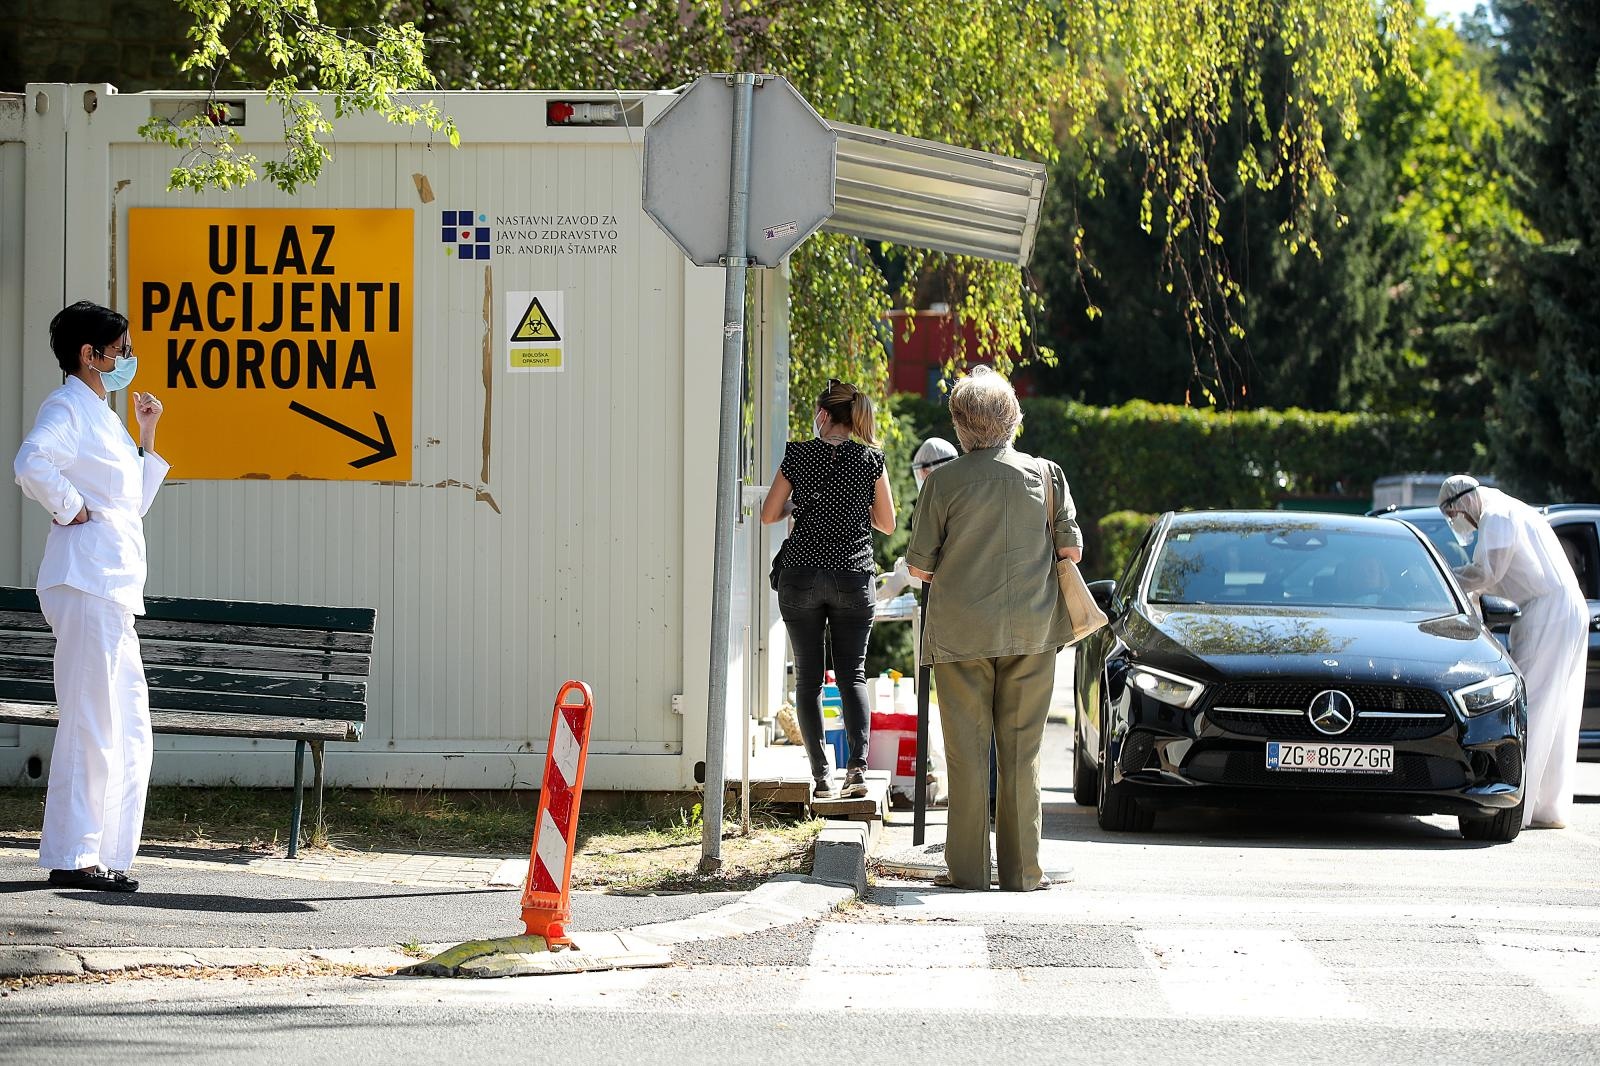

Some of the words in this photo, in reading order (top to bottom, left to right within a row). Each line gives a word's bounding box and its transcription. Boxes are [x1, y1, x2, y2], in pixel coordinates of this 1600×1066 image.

[496, 215, 553, 226] NASTAVNI
[556, 215, 599, 226] ZAVOD
[602, 215, 617, 225] ZA
[496, 230, 538, 241] JAVNO
[541, 230, 618, 240] ZDRAVSTVO
[209, 224, 335, 275] ULAZ
[496, 245, 515, 255] DR.
[518, 245, 565, 256] ANDRIJA
[567, 242, 617, 255] ŠTAMPAR
[142, 281, 400, 332] PACIJENTI
[167, 338, 376, 389] KORONA
[1281, 745, 1304, 766] ZG
